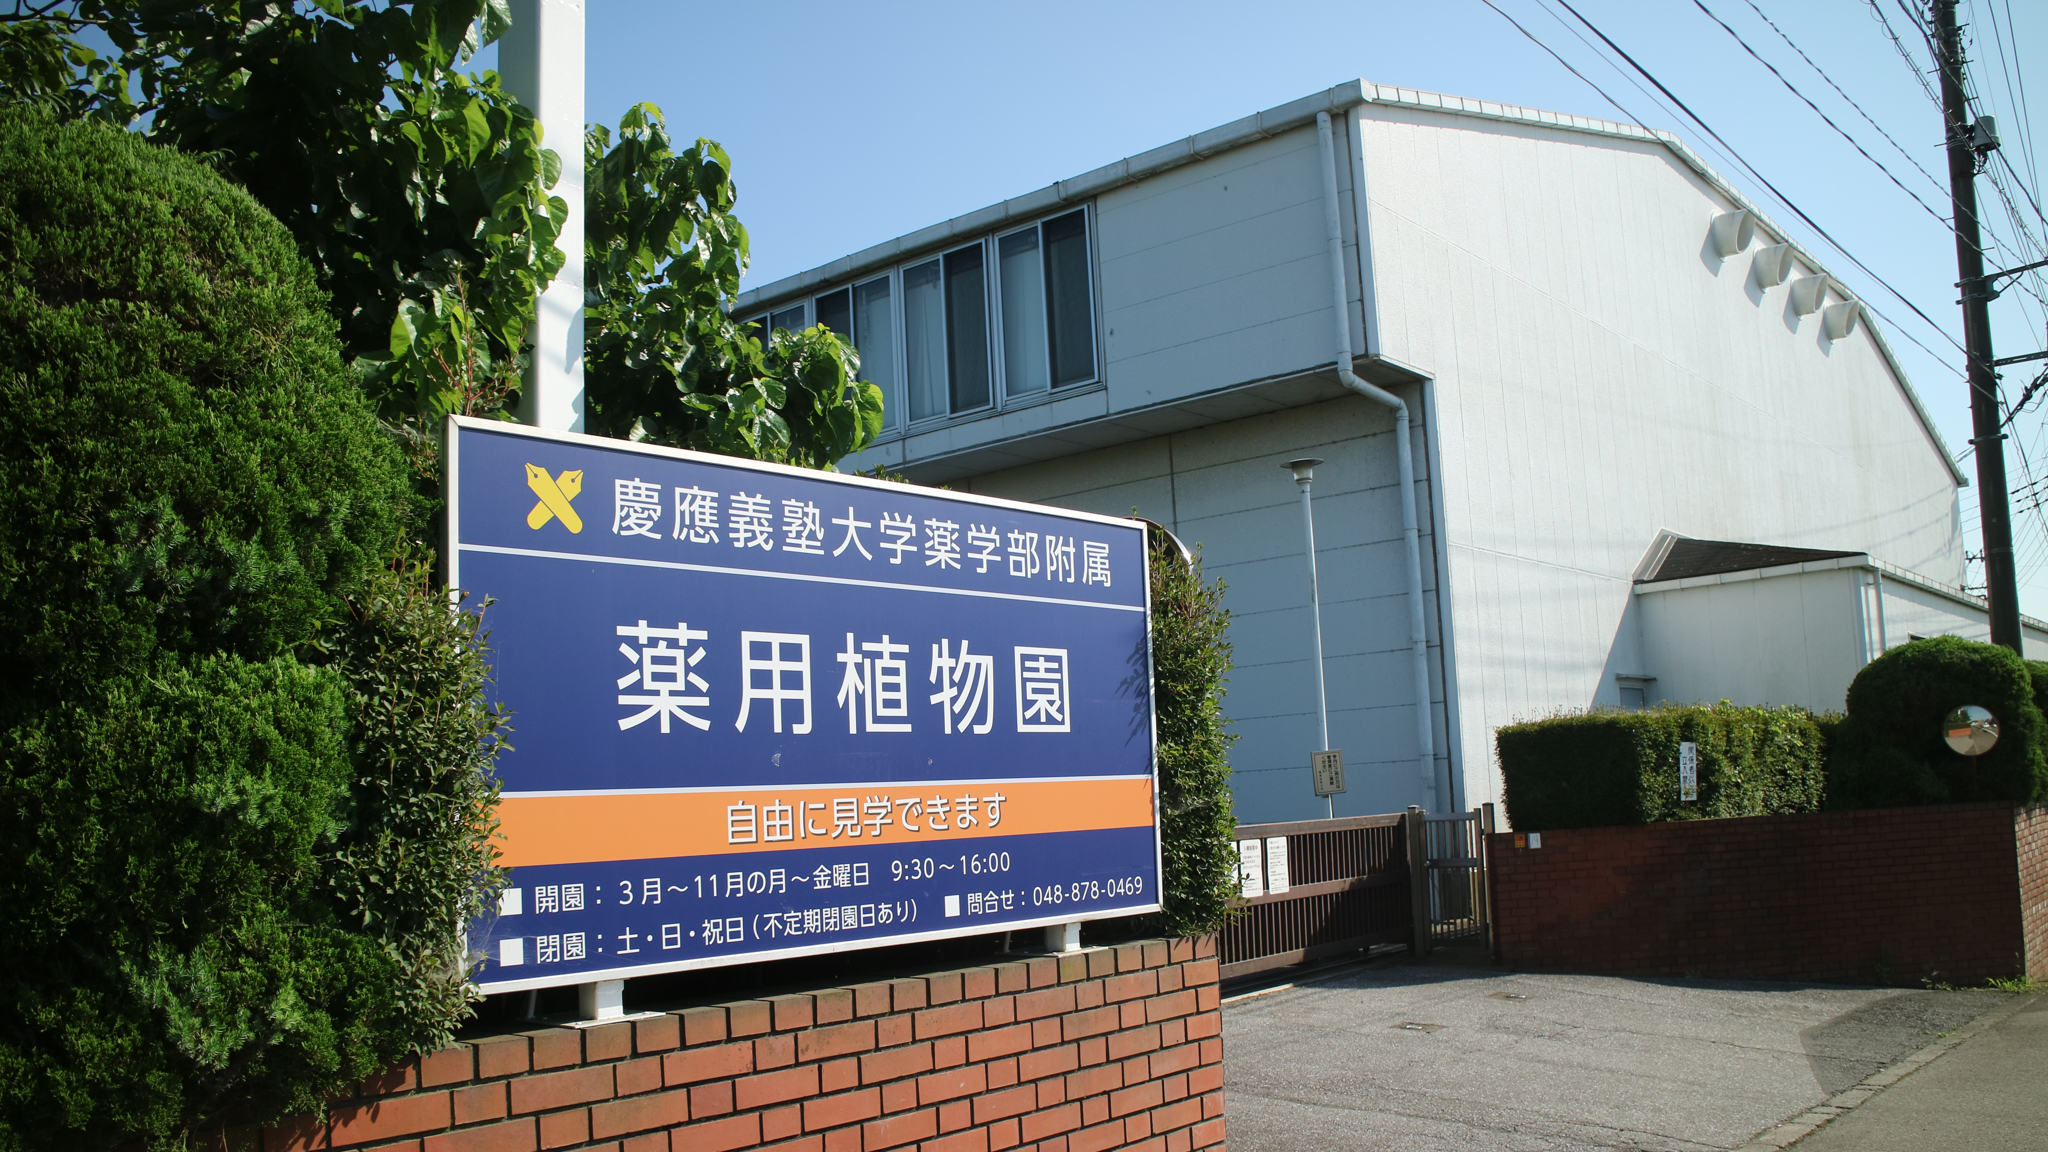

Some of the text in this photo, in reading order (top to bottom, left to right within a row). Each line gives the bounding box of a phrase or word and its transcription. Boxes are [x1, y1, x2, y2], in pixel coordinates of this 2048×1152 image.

[611, 476, 1112, 588] 慶應義塾大学薬学部附属
[615, 619, 1071, 735] 薬用植物園
[726, 791, 1006, 844] 自由に見学できます
[891, 851, 1011, 882] 9:30～16:00
